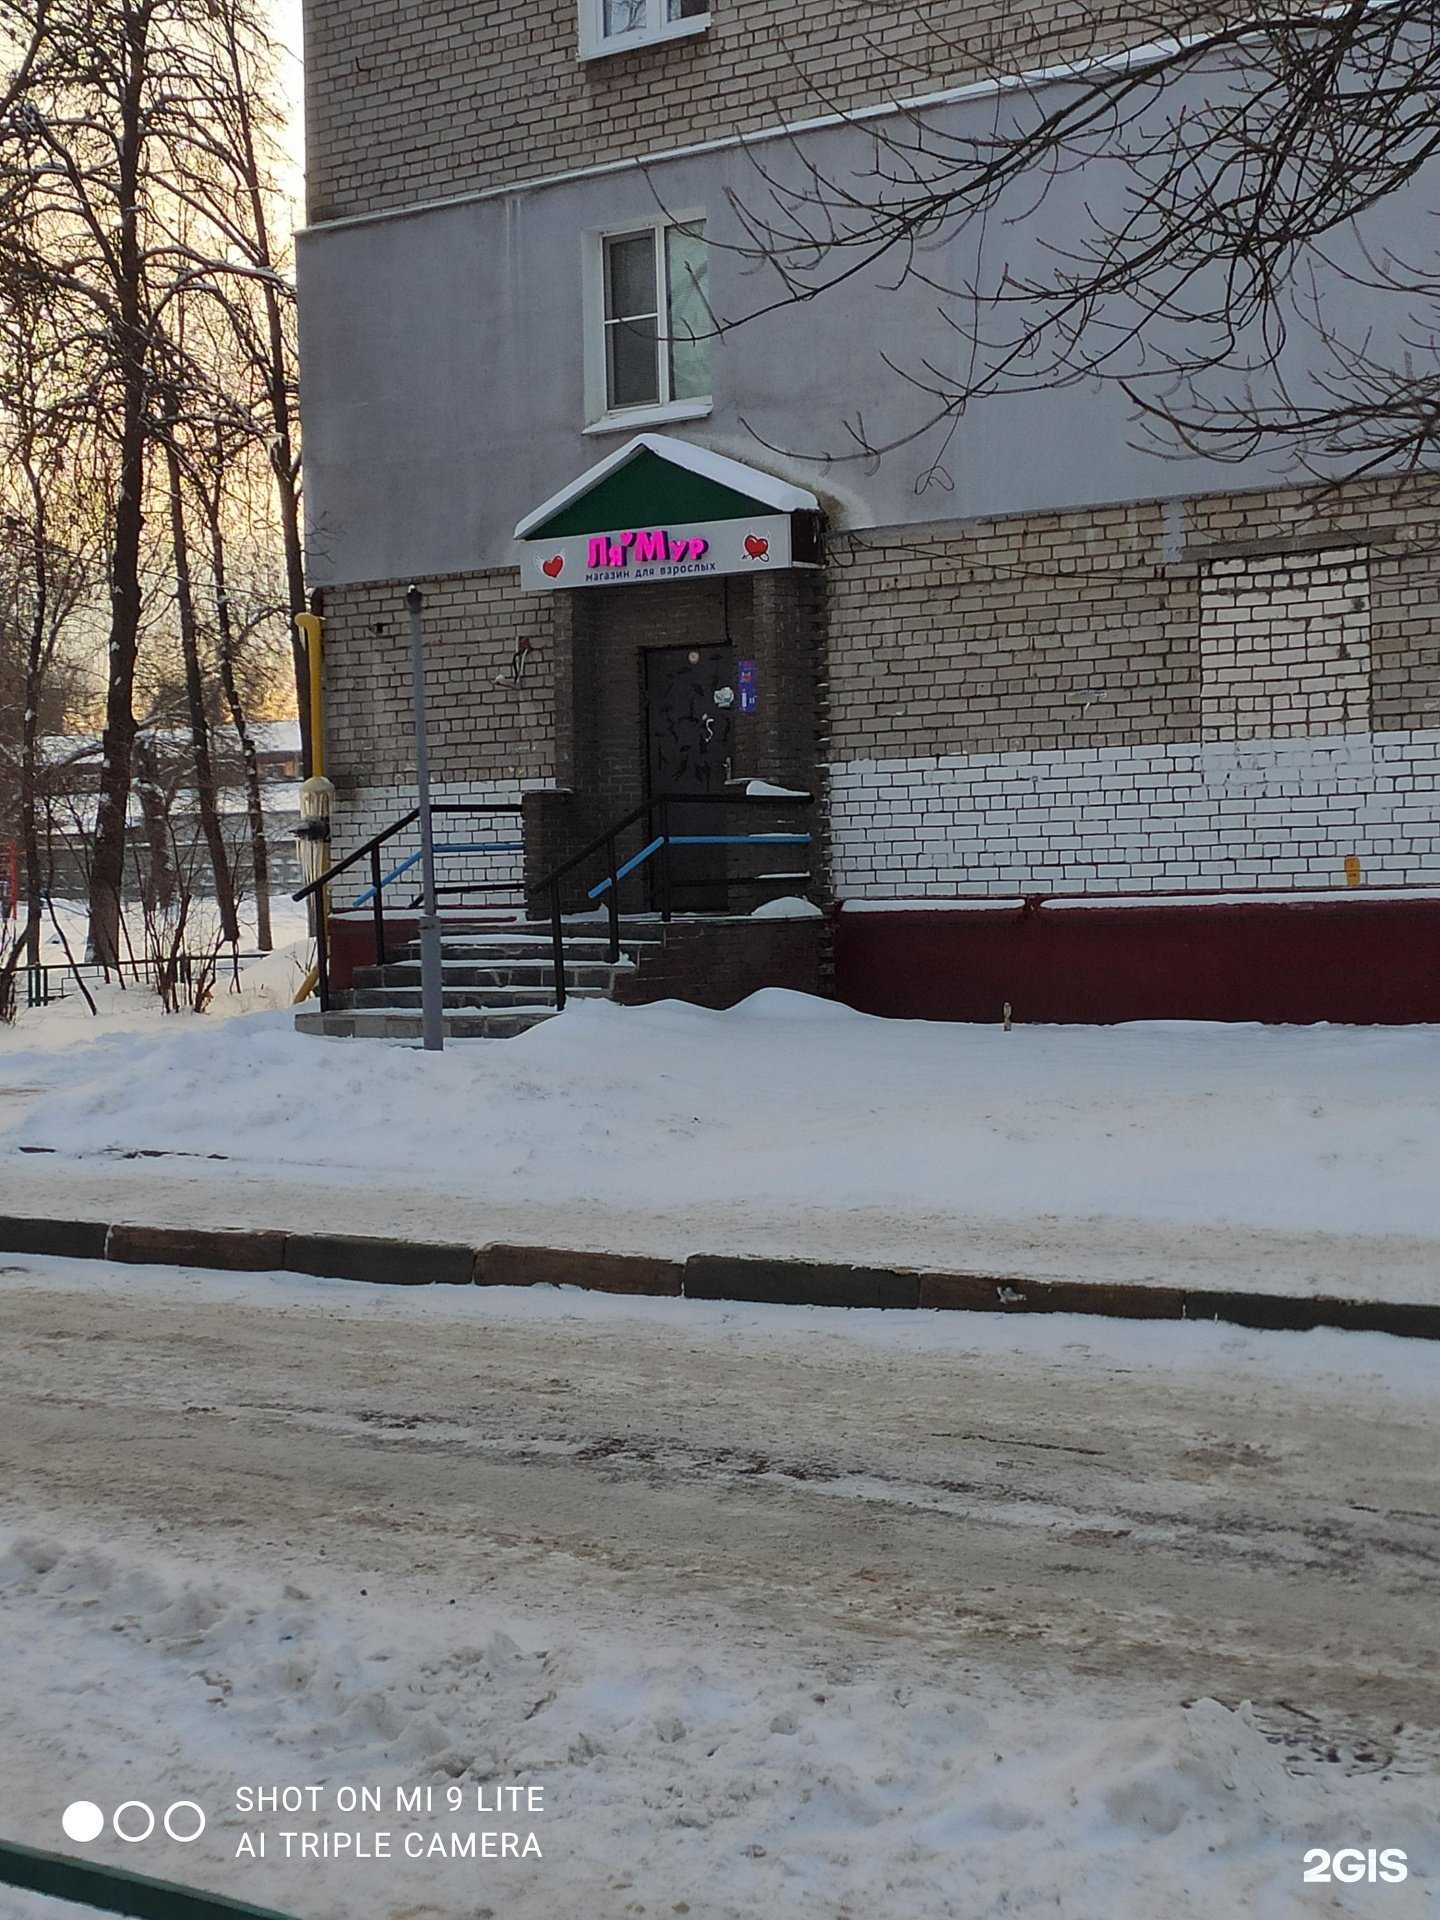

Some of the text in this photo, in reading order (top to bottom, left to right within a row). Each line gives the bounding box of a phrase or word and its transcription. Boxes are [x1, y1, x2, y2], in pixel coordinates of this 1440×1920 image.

[585, 562, 716, 582] магазин для взрослых
